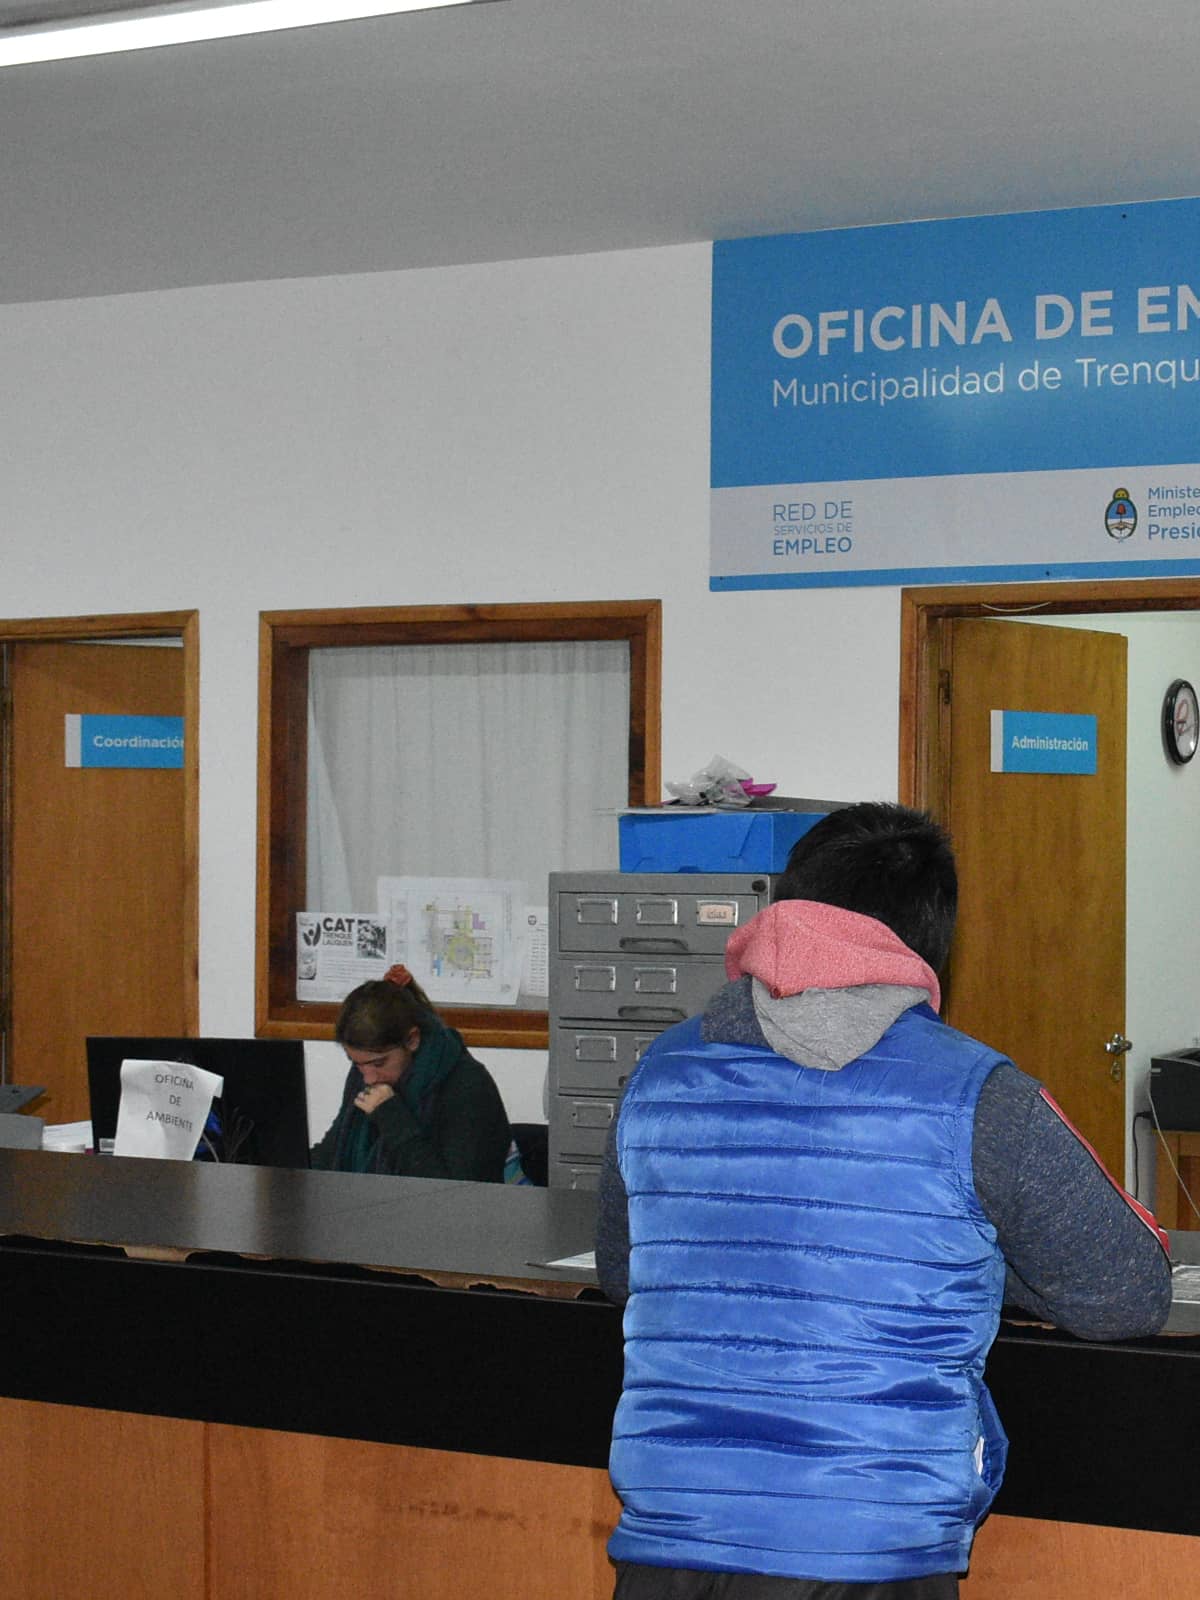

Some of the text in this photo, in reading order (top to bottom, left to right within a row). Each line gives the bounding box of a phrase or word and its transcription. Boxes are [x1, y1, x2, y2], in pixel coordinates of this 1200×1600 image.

[772, 297, 1013, 359] OFICINA
[1034, 289, 1114, 340] DE
[772, 362, 1005, 407] Municipalidad
[1018, 359, 1062, 391] de
[772, 500, 854, 522] RED DE
[773, 521, 854, 536] SERVICIOS DE
[772, 536, 853, 556] EMPLEO
[1010, 735, 1089, 751] Administración
[323, 917, 355, 933] CAT
[155, 1073, 194, 1090] OFICINA
[169, 1094, 182, 1106] DE
[146, 1110, 193, 1132] AMBIENTE
